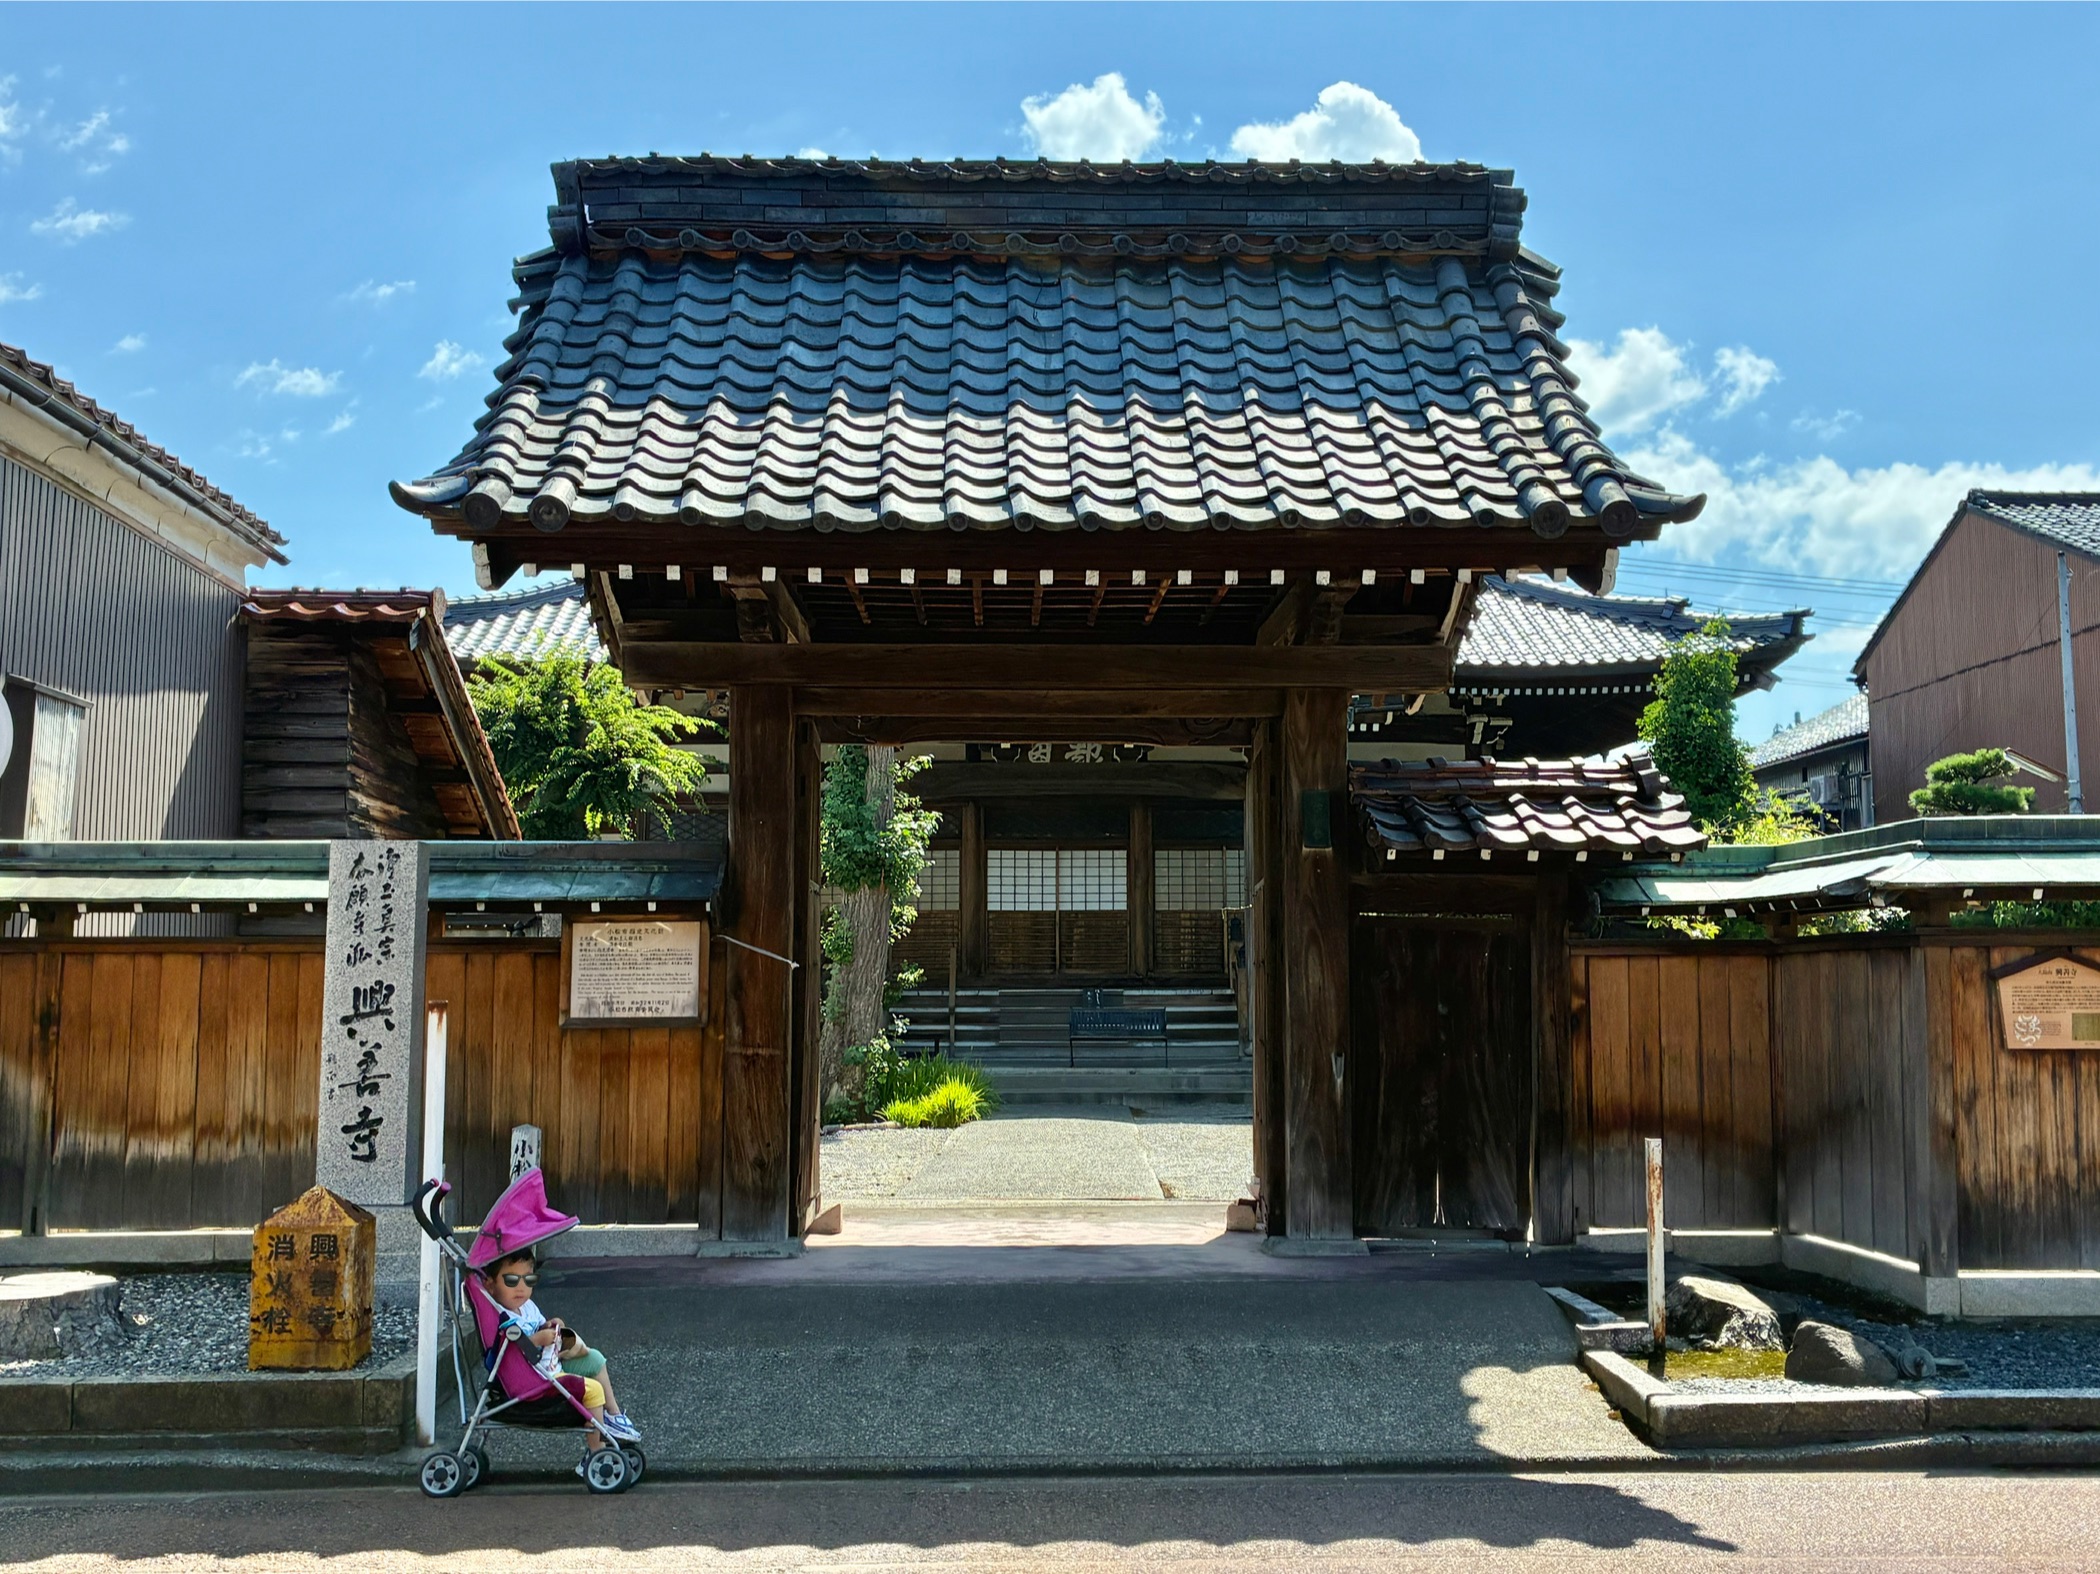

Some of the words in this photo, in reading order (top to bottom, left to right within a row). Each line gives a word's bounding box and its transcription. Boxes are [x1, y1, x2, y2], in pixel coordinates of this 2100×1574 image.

[338, 980, 395, 1163] 興善寺
[262, 1233, 296, 1335] 消火栓
